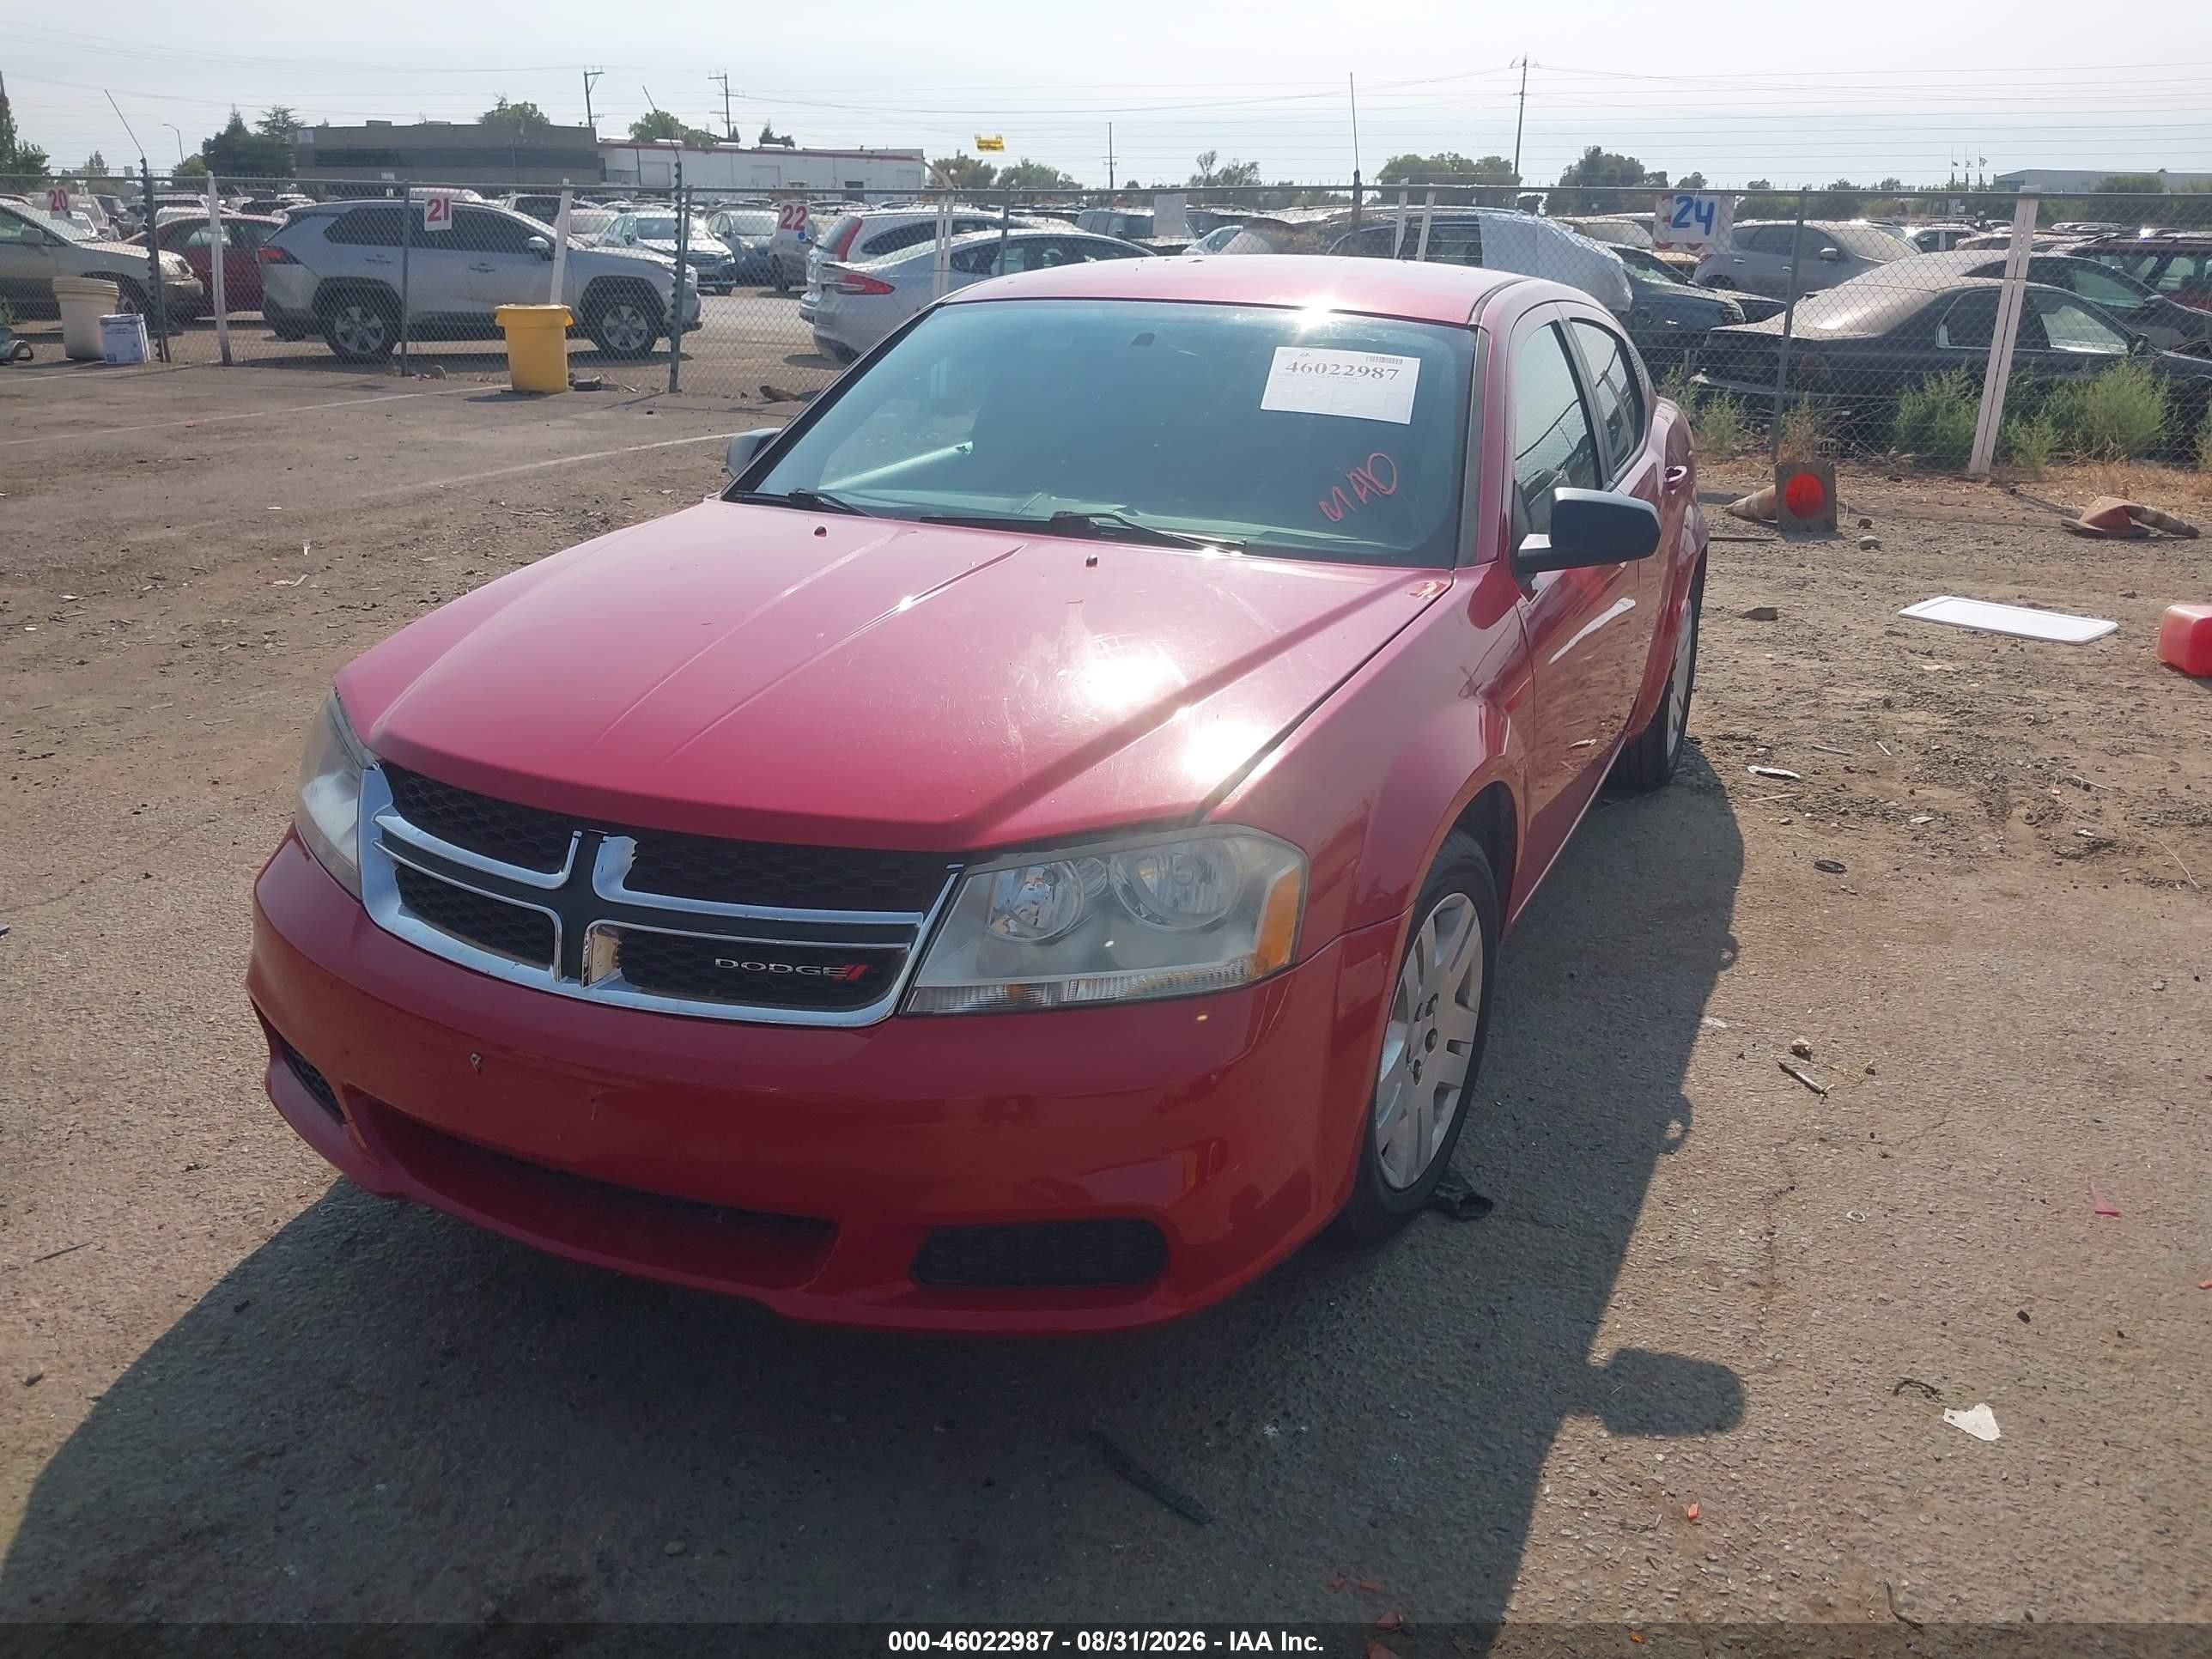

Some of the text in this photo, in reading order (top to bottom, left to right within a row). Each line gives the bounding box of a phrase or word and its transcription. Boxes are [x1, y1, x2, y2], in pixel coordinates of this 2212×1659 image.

[49, 189, 68, 211] 20
[427, 198, 449, 222] 21
[781, 204, 807, 231] 22
[1672, 196, 1714, 235] 24
[1285, 362, 1401, 380] 46022987
[714, 957, 848, 977] DODGE
